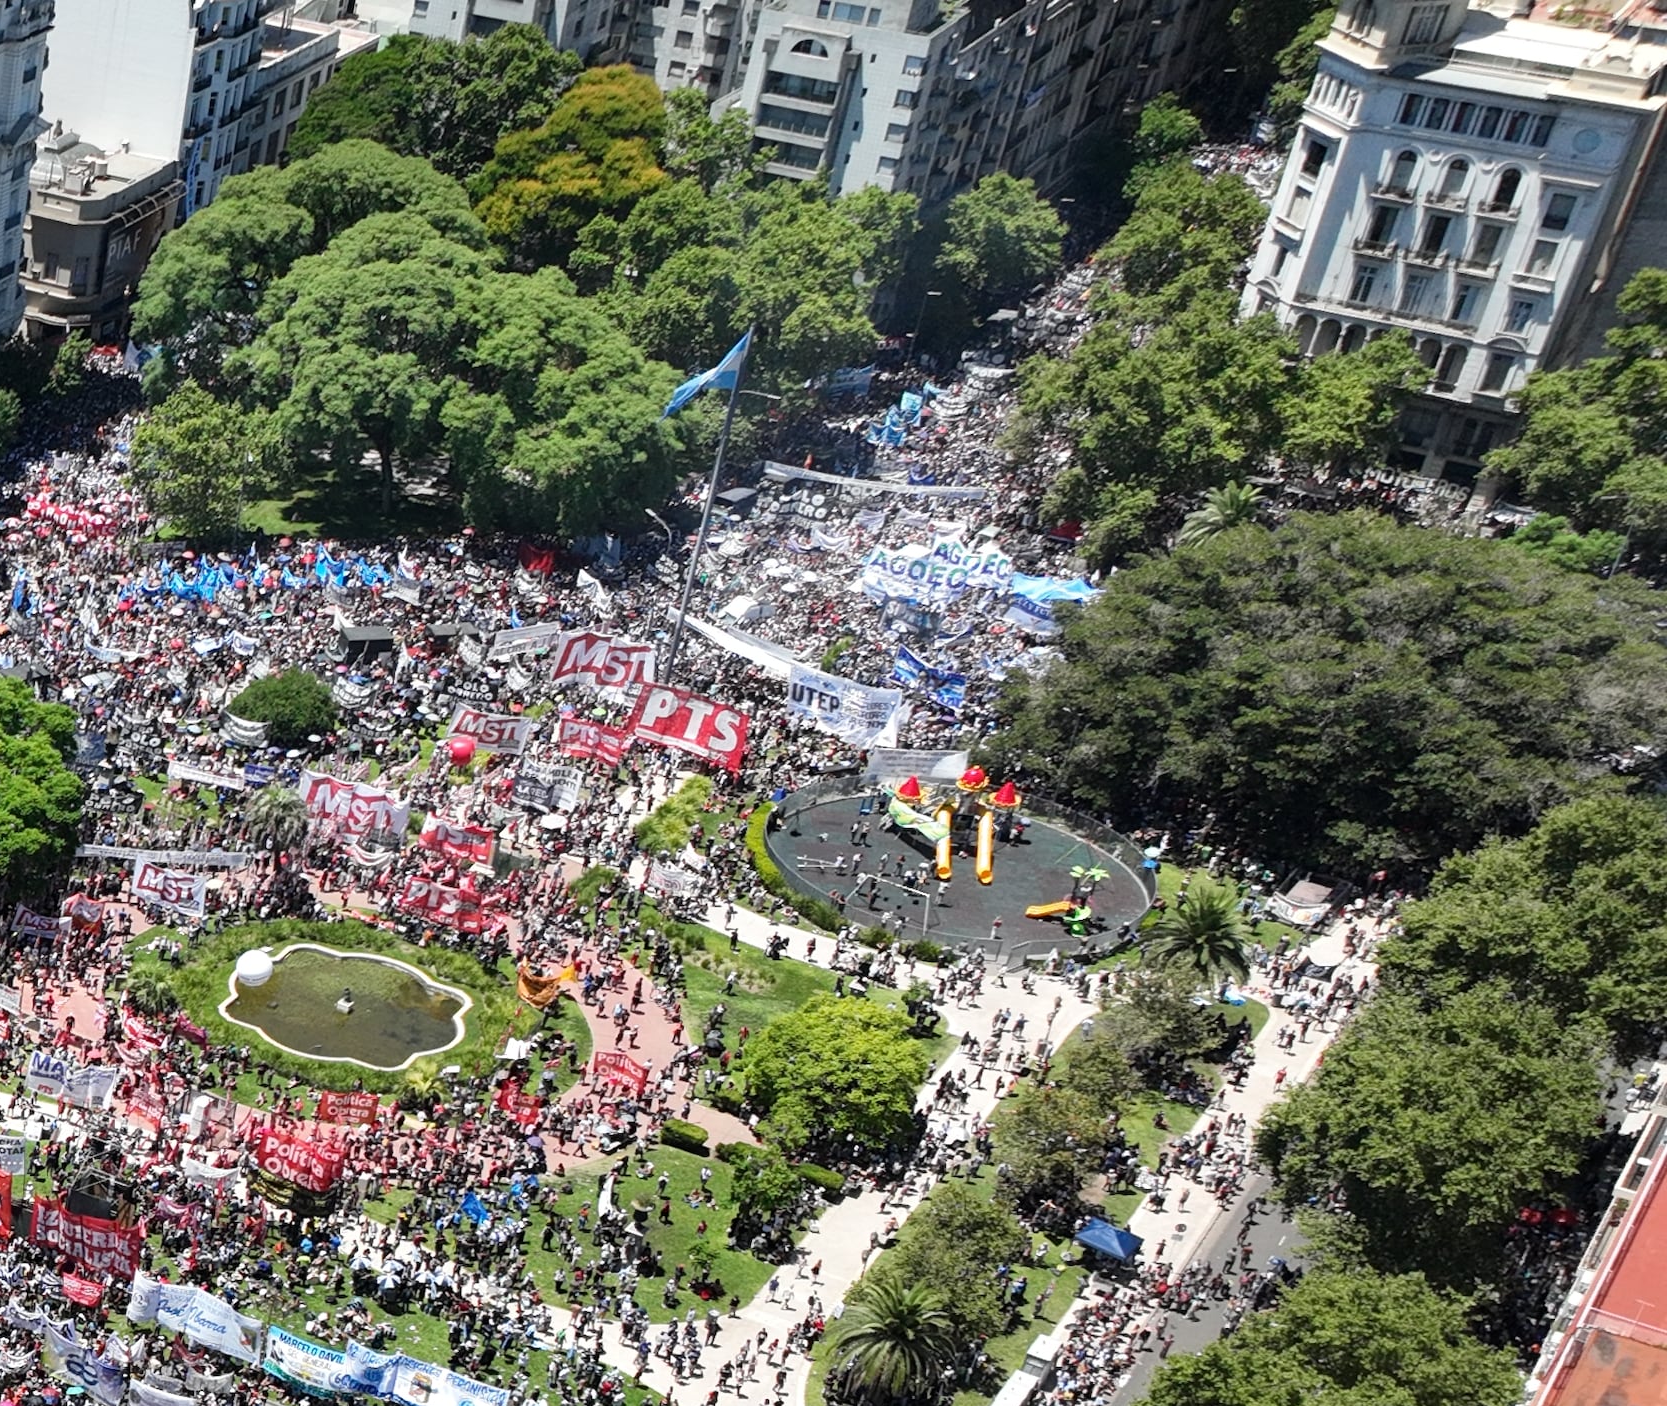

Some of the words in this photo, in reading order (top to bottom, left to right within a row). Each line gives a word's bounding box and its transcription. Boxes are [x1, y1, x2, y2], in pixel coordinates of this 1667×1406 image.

[107, 229, 142, 266] PIAF
[870, 550, 969, 589] AGOEC
[564, 639, 651, 683] MST
[791, 683, 840, 713] UTEP
[461, 714, 516, 742] MST
[563, 723, 599, 745] PTS
[637, 688, 740, 752] PTS
[314, 782, 394, 835] MST
[142, 868, 193, 903] MST
[409, 883, 459, 914] PTS
[24, 912, 60, 931] MST
[327, 1106, 369, 1119] Obrera
[279, 1333, 318, 1355] MARCELO
